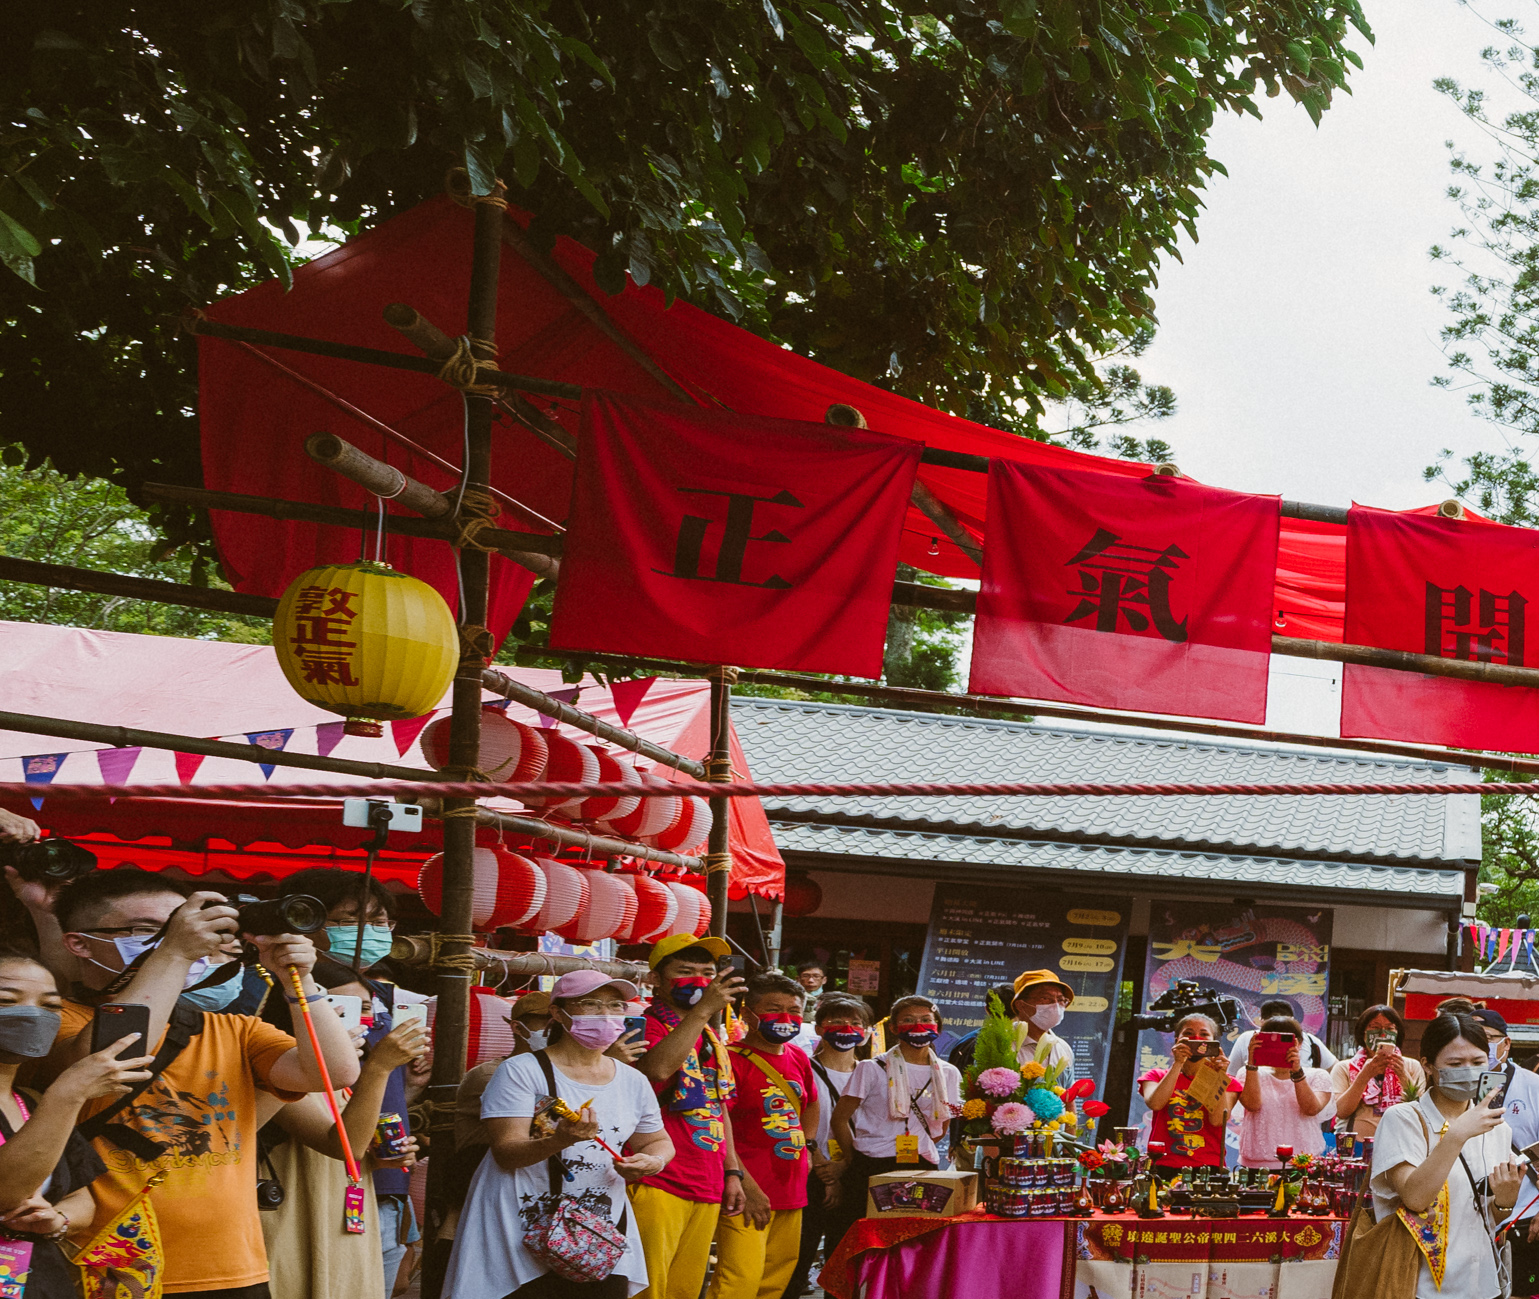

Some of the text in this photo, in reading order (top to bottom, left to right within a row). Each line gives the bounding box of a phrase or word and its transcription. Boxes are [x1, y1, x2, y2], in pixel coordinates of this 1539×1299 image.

[651, 487, 806, 590] 正
[1064, 528, 1191, 643] 氣
[294, 584, 361, 689] 敦正氣
